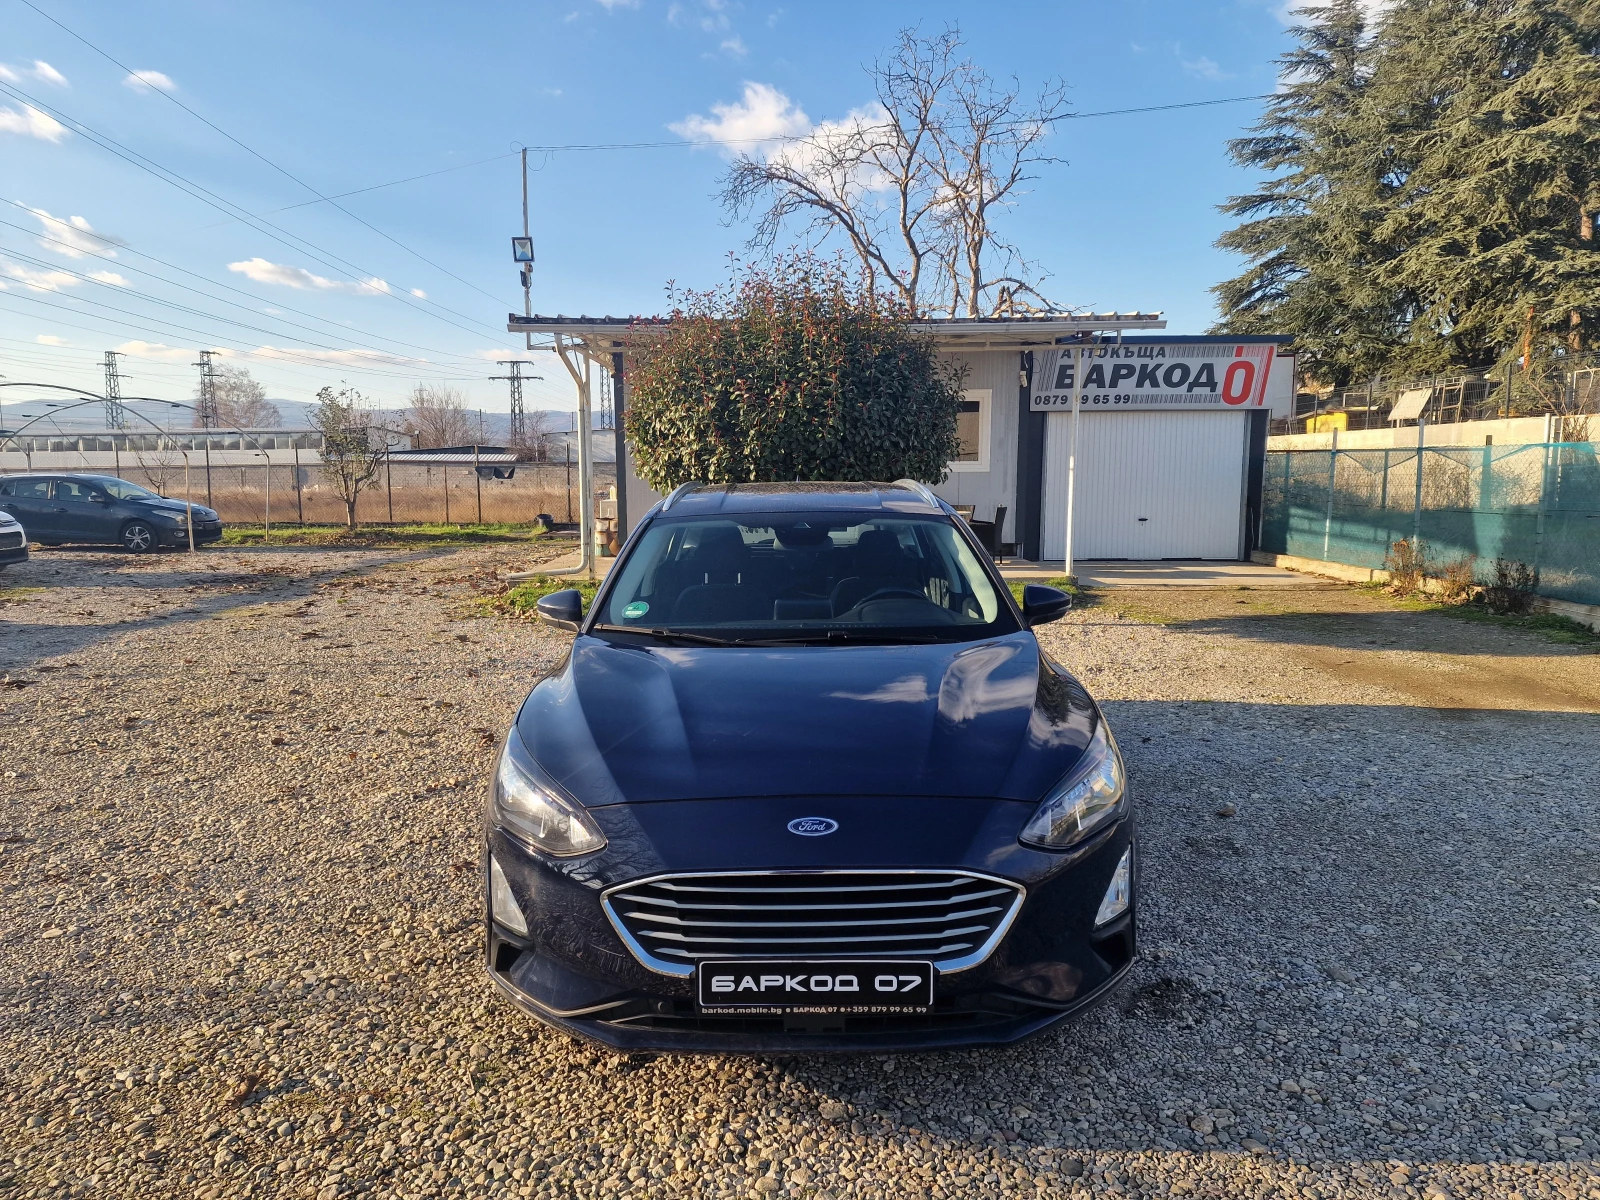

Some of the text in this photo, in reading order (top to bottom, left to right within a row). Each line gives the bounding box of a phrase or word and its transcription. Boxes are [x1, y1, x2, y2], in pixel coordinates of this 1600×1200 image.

[1054, 363, 1218, 393] БАРКОД
[1034, 394, 1069, 406] 0879
[1092, 394, 1110, 405] 65
[1113, 394, 1131, 405] 99
[798, 820, 827, 831] Ford
[711, 975, 922, 992] БАРКОД 07
[701, 1007, 783, 1015] barkod.mobile.bg
[793, 1006, 827, 1015] БАРКОД
[915, 1006, 927, 1014] 99
